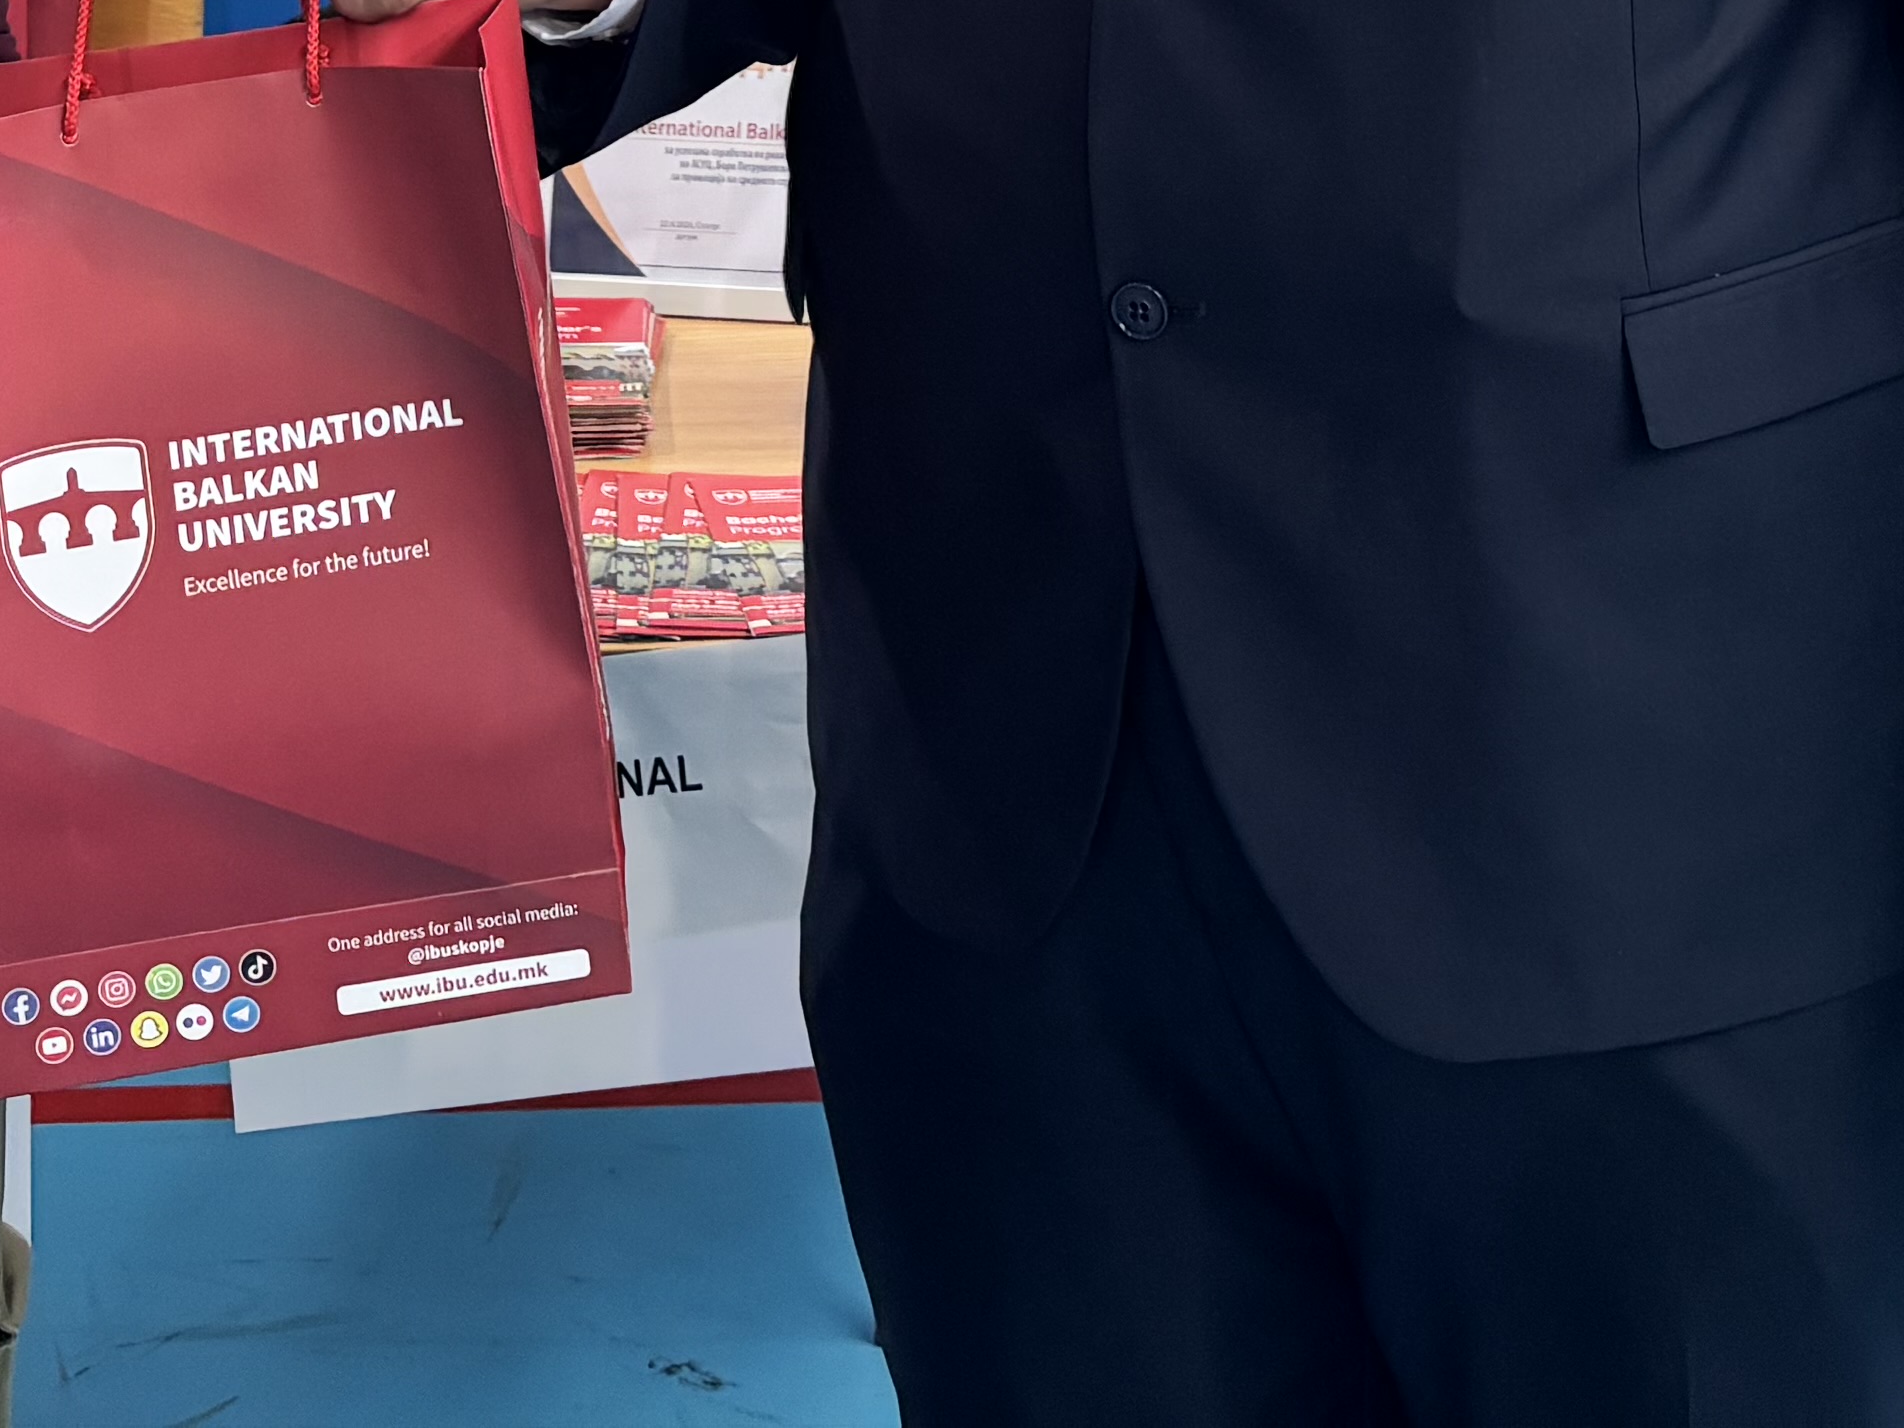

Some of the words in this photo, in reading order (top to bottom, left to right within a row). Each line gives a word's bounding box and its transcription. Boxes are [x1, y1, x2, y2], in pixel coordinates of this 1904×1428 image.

[168, 398, 464, 470] INTERNATIONAL
[173, 460, 319, 512] BALKAN
[177, 489, 396, 552] UNIVERSITY
[183, 565, 288, 597] Excellence
[292, 558, 321, 579] for
[324, 551, 359, 574] the
[362, 538, 431, 567] future!
[327, 936, 361, 953] One
[363, 927, 426, 948] address
[428, 920, 451, 937] for
[453, 915, 474, 932] all
[476, 908, 522, 930] social
[524, 902, 579, 923] media:
[407, 934, 505, 965] @ibuskopje
[379, 961, 549, 1004] www.ibu.edu.mk
